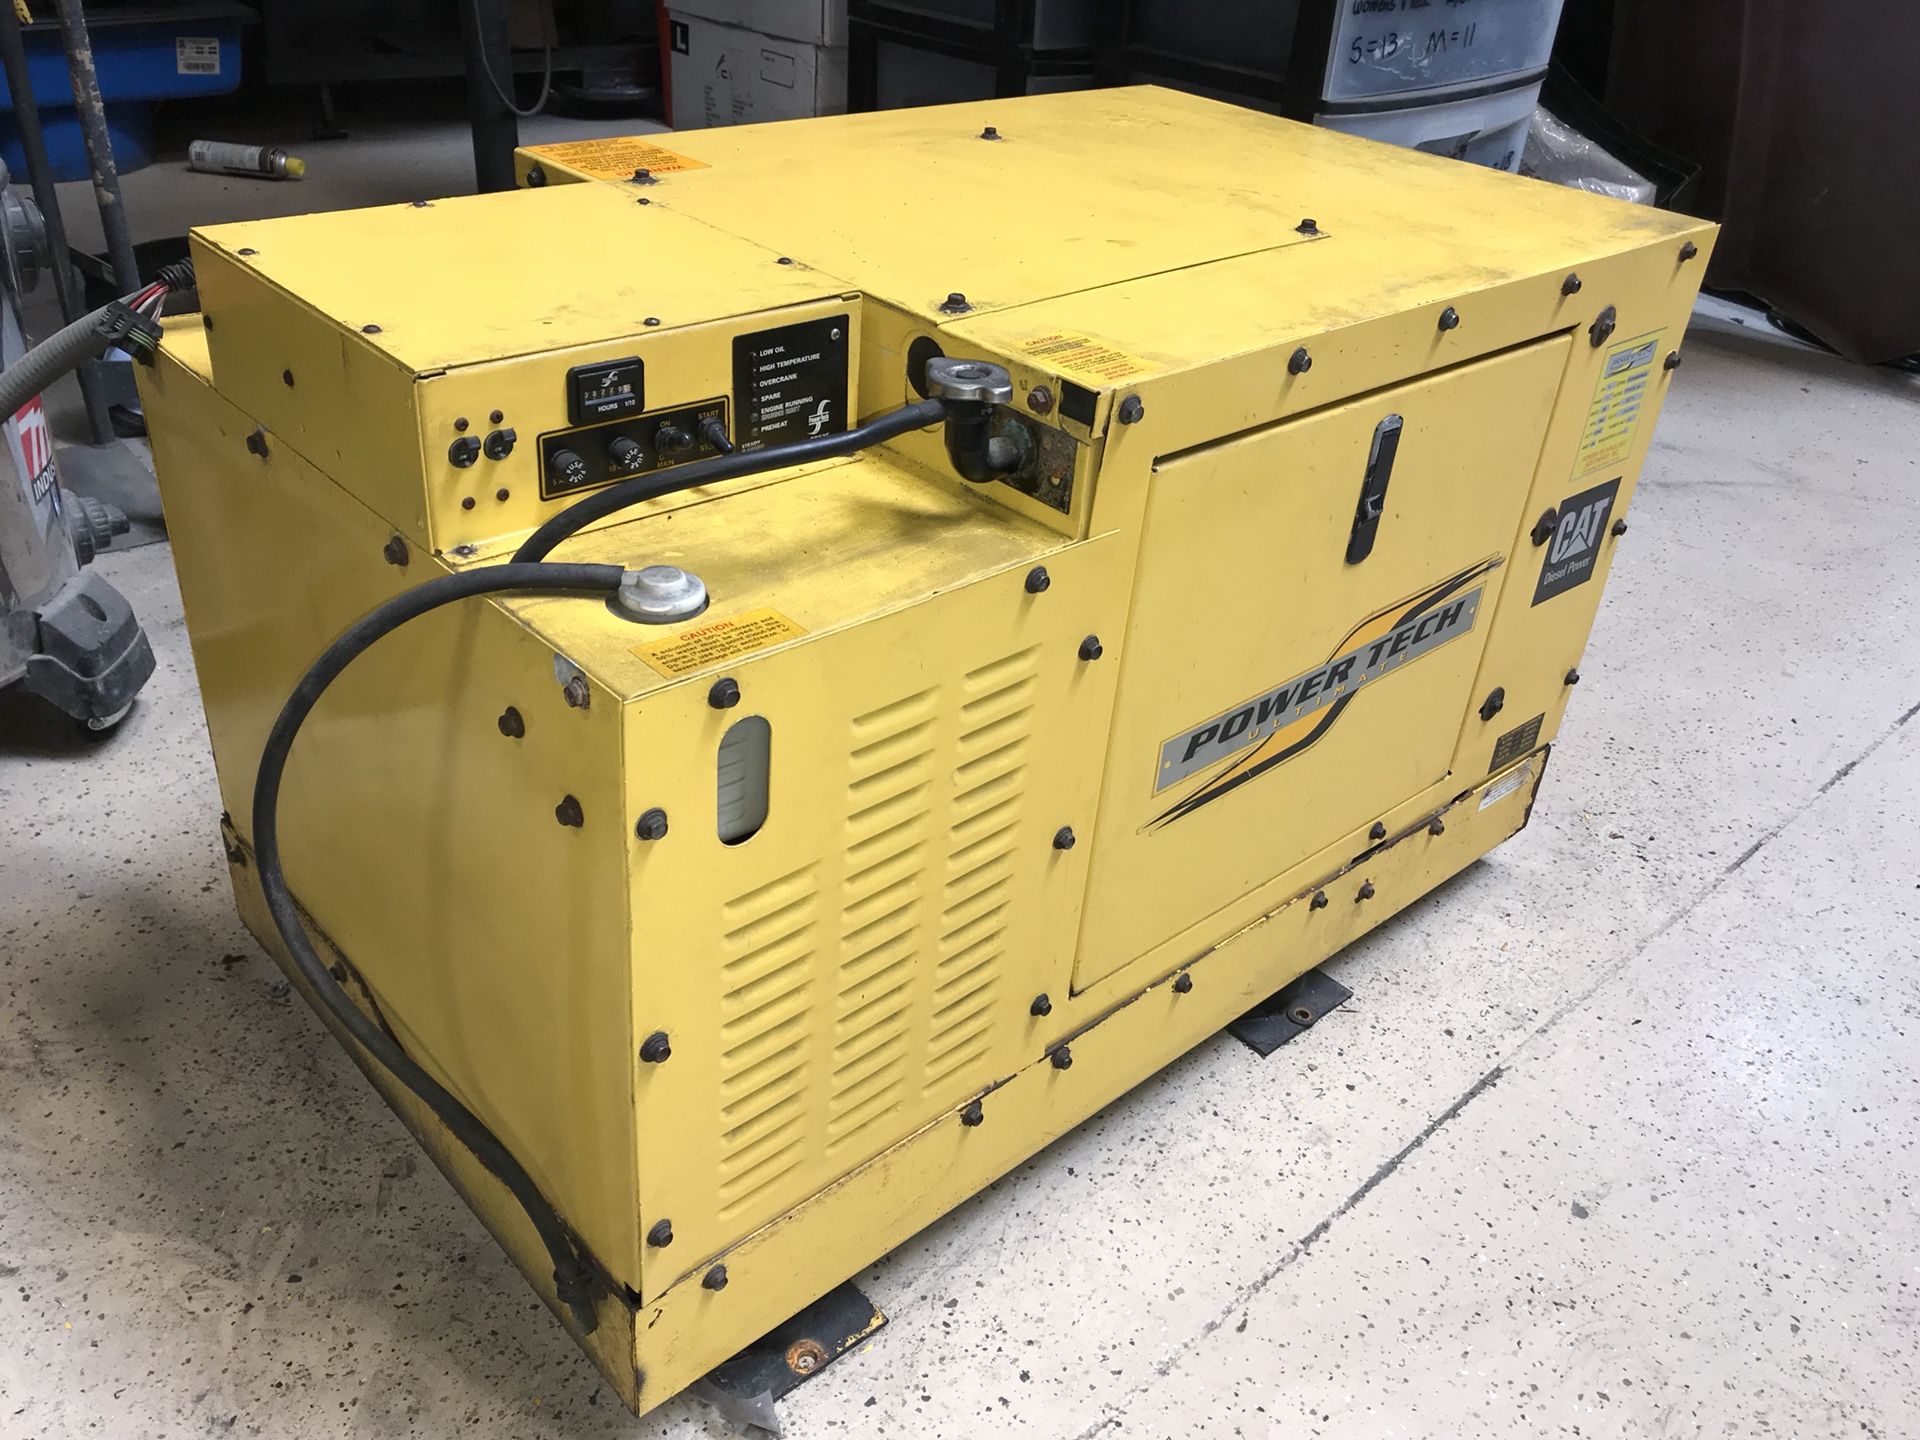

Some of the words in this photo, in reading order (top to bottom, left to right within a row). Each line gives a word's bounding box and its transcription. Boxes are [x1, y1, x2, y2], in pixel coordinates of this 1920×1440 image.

[676, 25, 687, 49] L
[760, 347, 774, 357] LOW
[760, 363, 776, 372] HIGH
[776, 353, 820, 368] TEMPERATURE
[759, 373, 798, 387] OVERCRANK
[761, 392, 781, 402] SPARE
[761, 403, 784, 414] ENGINE
[785, 396, 814, 408] RUNNING
[598, 403, 618, 412] HOURS
[698, 409, 719, 420] START
[660, 420, 671, 428] ON
[761, 420, 789, 432] PREHEAT
[657, 459, 674, 467] MAIN
[1550, 497, 1611, 564] CAT
[1543, 564, 1568, 586] Diesel
[1567, 557, 1592, 574] Power
[680, 621, 735, 642] CAUTION
[676, 646, 697, 655] water
[735, 628, 753, 636] used
[1181, 655, 1357, 763] POWER
[1366, 600, 1466, 669] TECH
[1248, 650, 1409, 740] ULTIMATE
